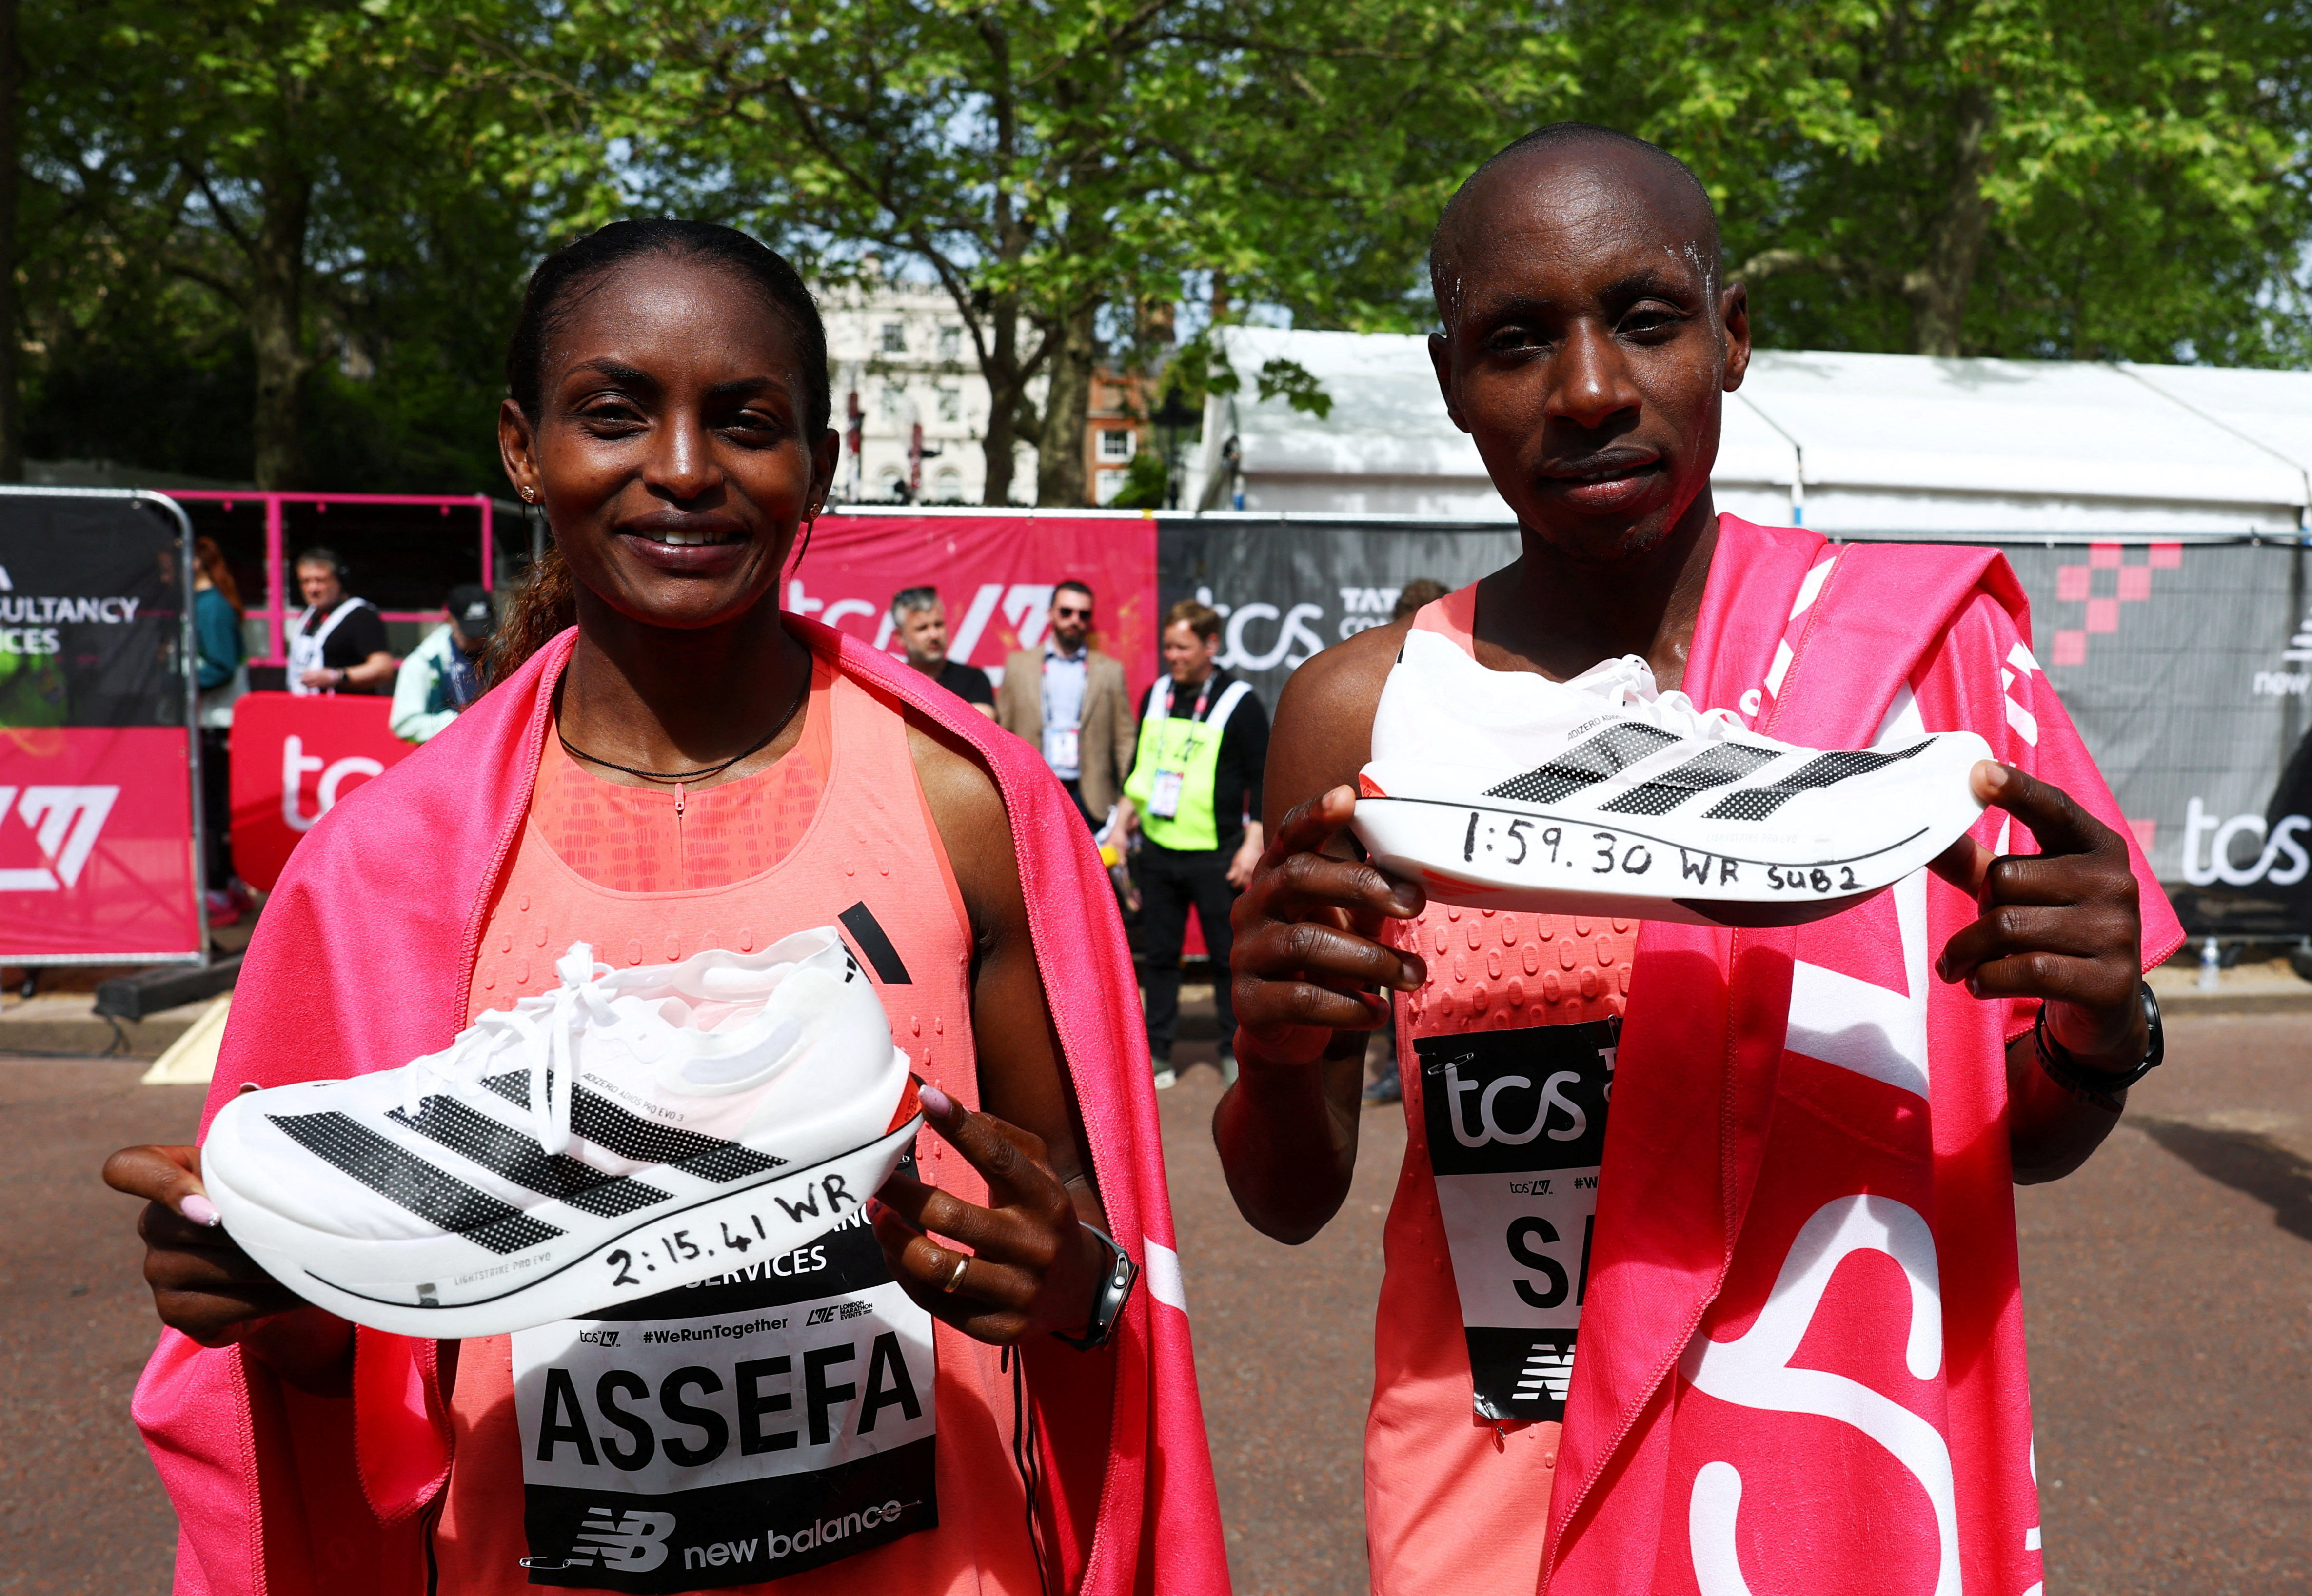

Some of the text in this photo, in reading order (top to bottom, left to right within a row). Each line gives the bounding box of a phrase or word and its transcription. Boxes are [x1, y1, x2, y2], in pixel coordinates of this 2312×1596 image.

[0, 596, 140, 624] ULTANCY
[1339, 587, 1402, 613] TAT
[2253, 670, 2311, 696] new
[1568, 717, 1601, 741] ADIZERO
[1464, 812, 1652, 875] 1:59.30
[1680, 848, 1739, 886] WR
[2182, 796, 2312, 886] tcs
[582, 1073, 619, 1093] ADIZERO
[619, 1091, 643, 1106] ADIOS
[643, 1101, 657, 1114] PRO
[658, 1108, 676, 1120] EVO
[1445, 1062, 1586, 1148] tcs
[1510, 1182, 1529, 1194] tcs
[607, 1214, 766, 1286] 2:15.41
[775, 1174, 857, 1223] WR
[454, 1252, 551, 1285] LIGHTSTRIKE PRO EVO
[686, 1245, 827, 1288] RVICES
[840, 1300, 864, 1310] LONDON
[840, 1303, 873, 1315] MARATHON
[840, 1311, 862, 1320] EVENTS
[580, 1330, 598, 1343] tcs
[643, 1318, 788, 1343] #WeRunTogether
[536, 1331, 922, 1472] ASSEFA
[684, 1535, 758, 1570] new
[768, 1499, 902, 1558] balance
